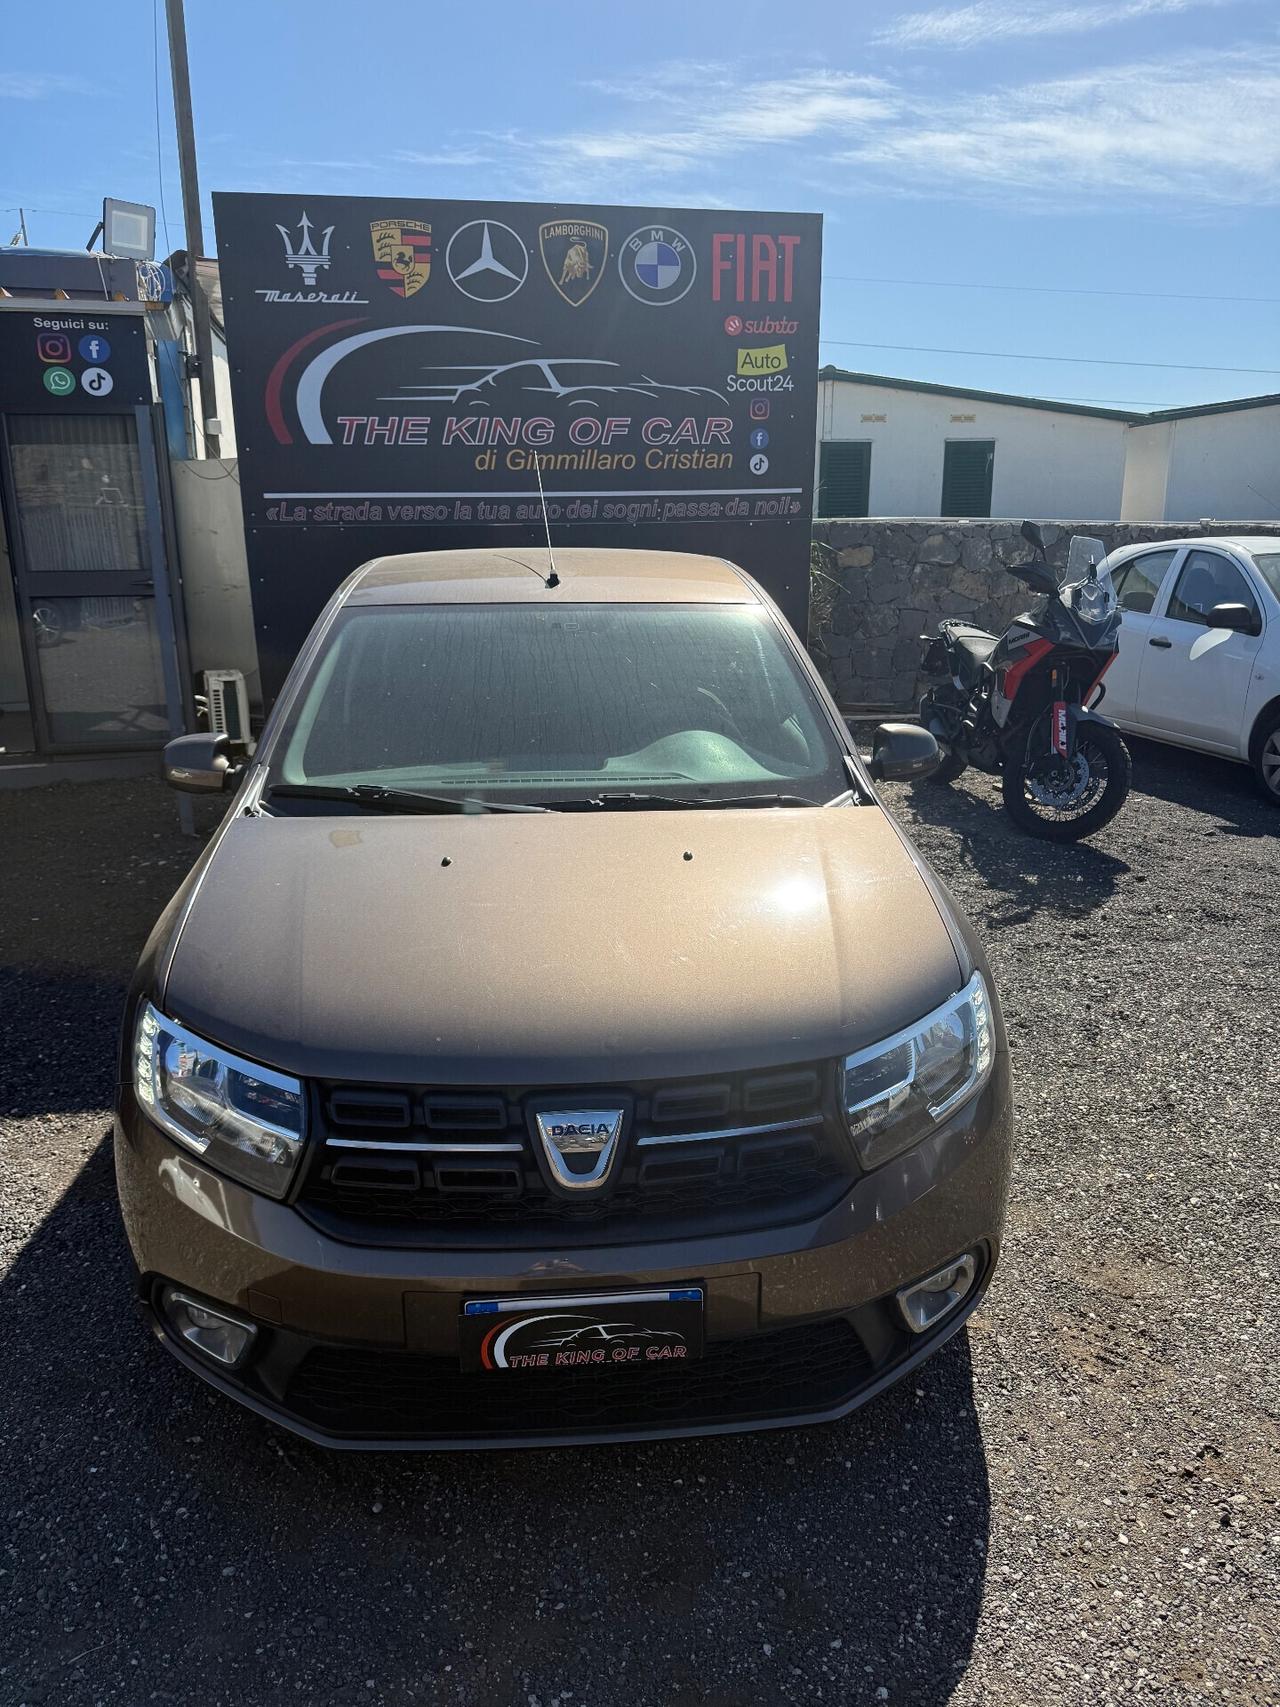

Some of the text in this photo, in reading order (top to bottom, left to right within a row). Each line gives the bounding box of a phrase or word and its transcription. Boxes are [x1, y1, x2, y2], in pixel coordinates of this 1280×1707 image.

[371, 220, 431, 230] PORSCHE
[544, 224, 604, 241] LAMBORGHINI
[628, 230, 686, 252] BMW
[712, 233, 800, 302] FIAT
[255, 290, 369, 303] Maserati
[33, 317, 109, 331] Seguici su:
[744, 316, 799, 334] subito
[741, 352, 782, 369] Auto
[726, 374, 795, 392] Scout24
[337, 416, 734, 446] THE KING OF CAR
[475, 449, 734, 471] di Gimmillaro Cristian
[313, 502, 382, 521] strada
[387, 506, 447, 521] verso
[453, 500, 472, 520] la
[477, 502, 511, 520] tua
[516, 501, 561, 519] auto
[566, 500, 599, 518] dei
[603, 499, 658, 522] sogni
[663, 502, 721, 521] passa
[725, 498, 750, 516] da
[551, 1123, 610, 1136] DACIA
[509, 1353, 550, 1368] THE
[555, 1349, 605, 1365] KING
[612, 1347, 640, 1360] OF
[645, 1345, 688, 1359] CAR
